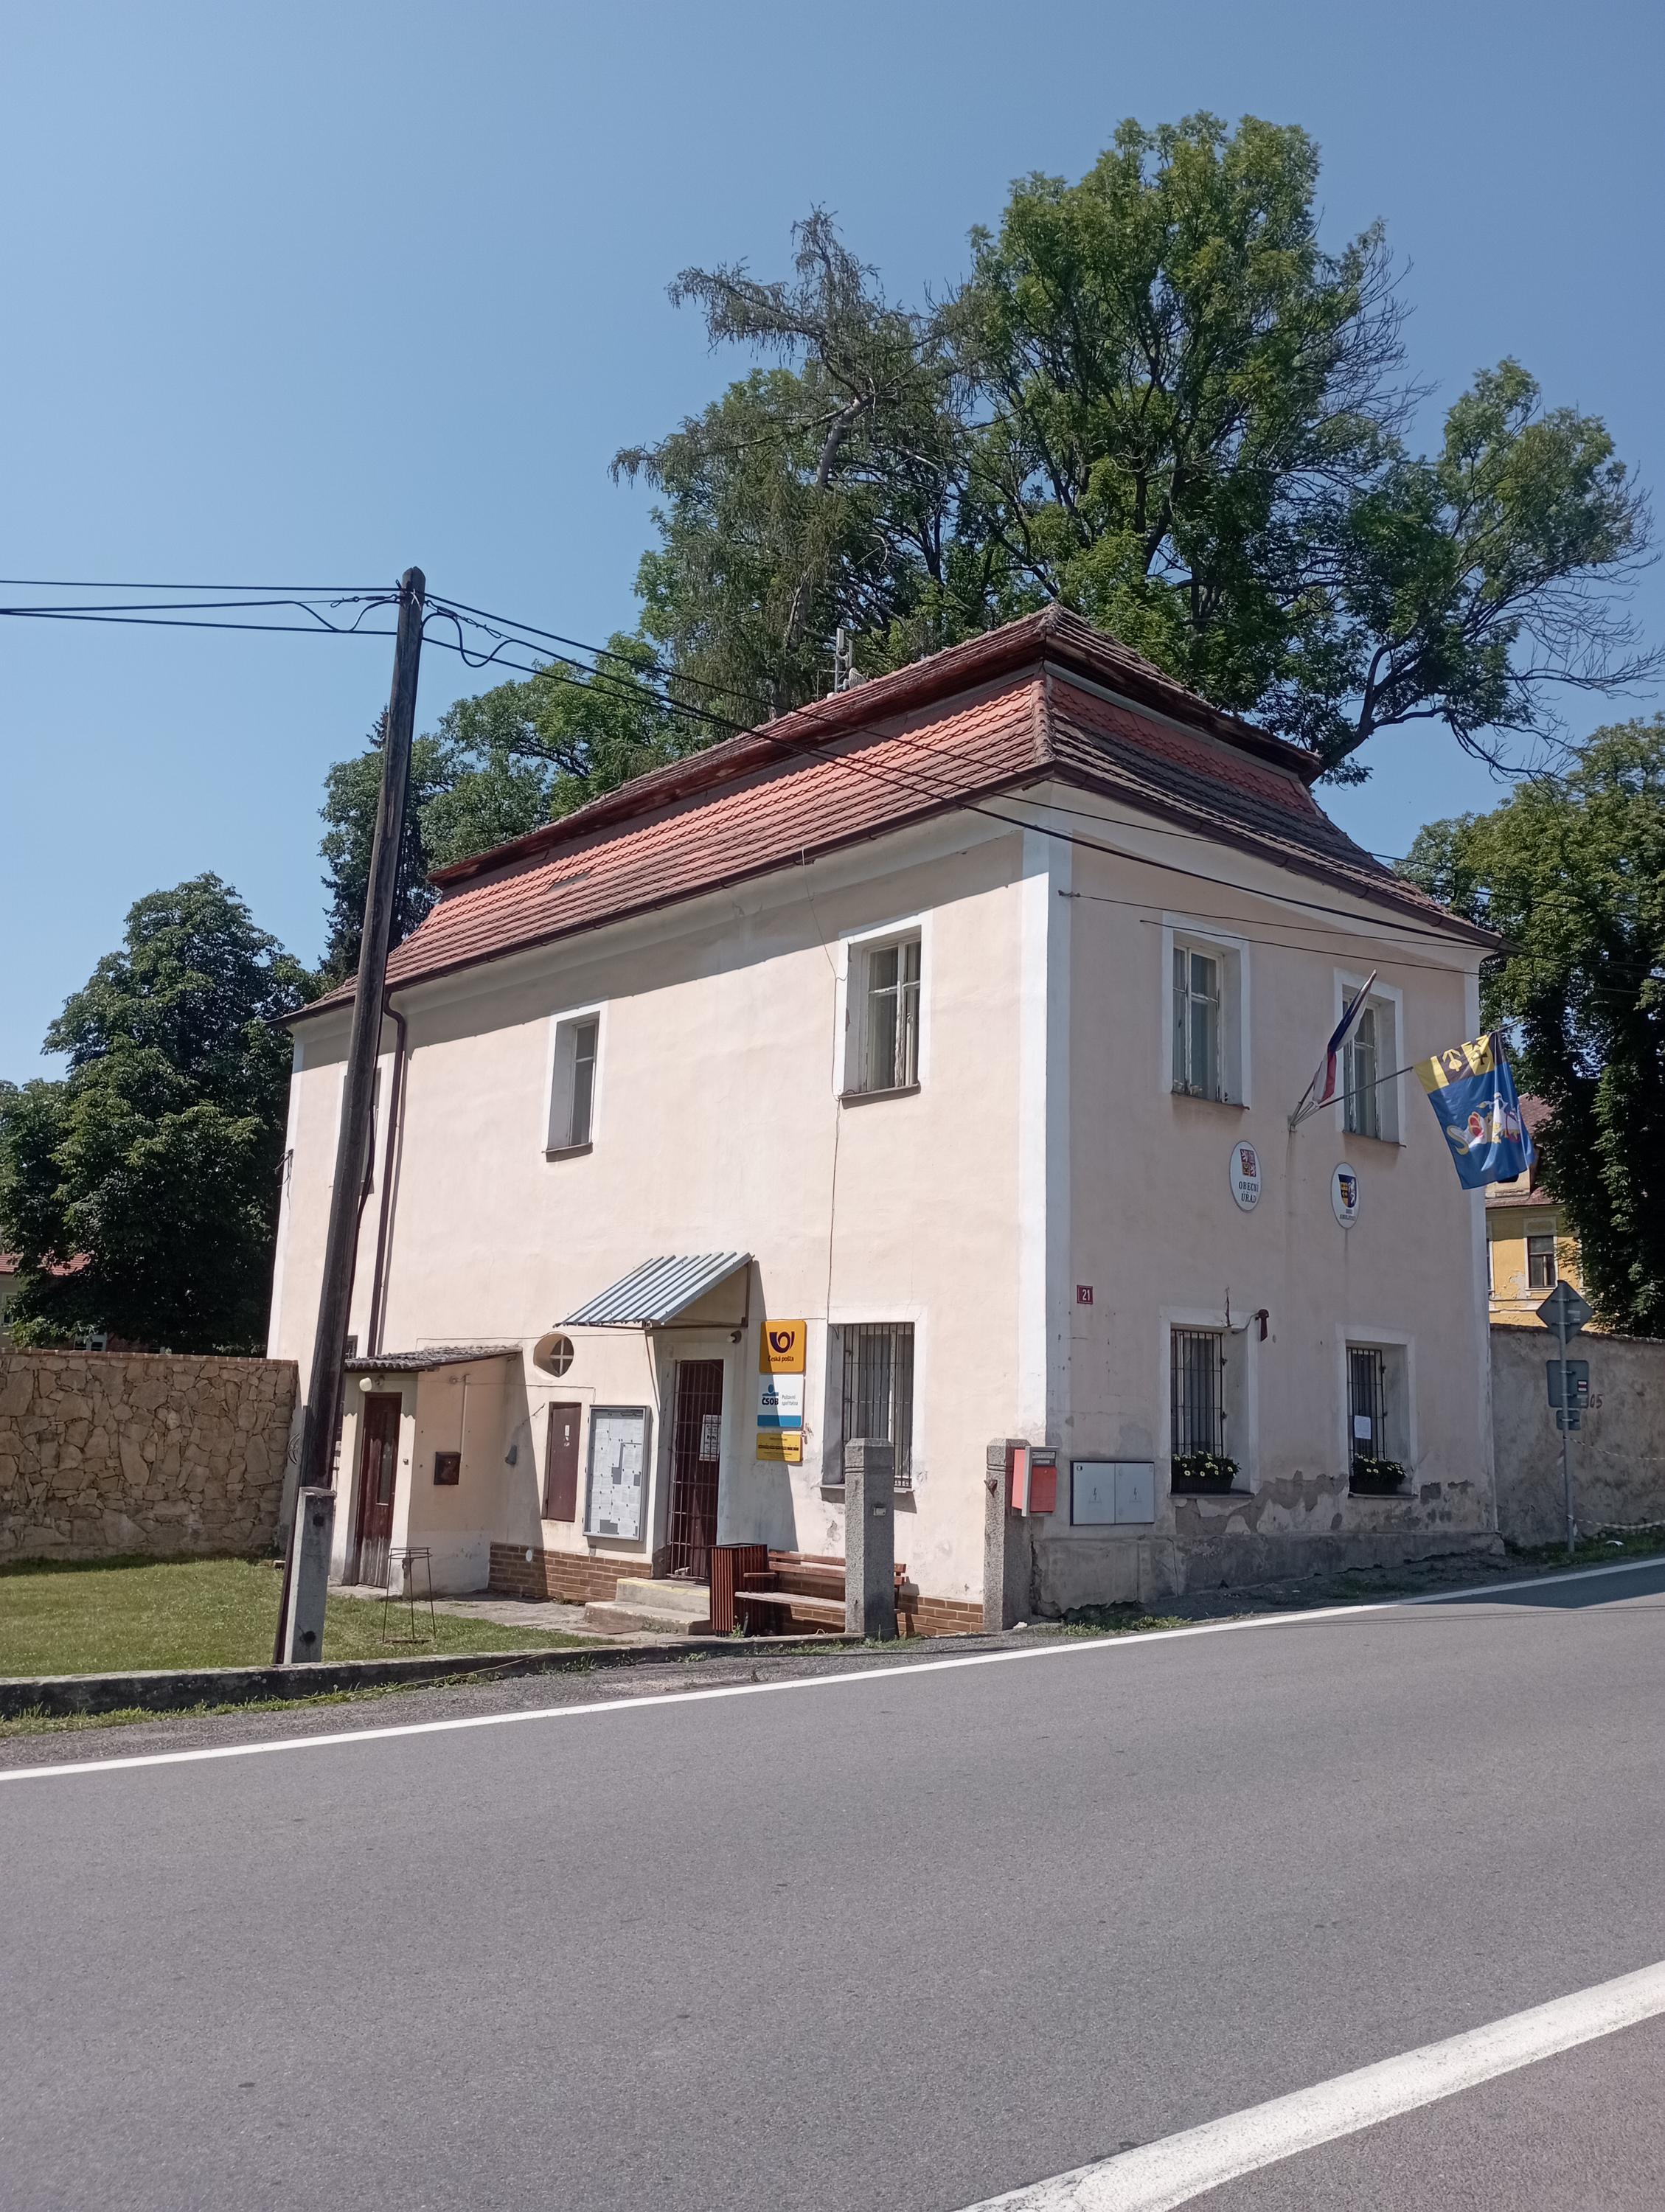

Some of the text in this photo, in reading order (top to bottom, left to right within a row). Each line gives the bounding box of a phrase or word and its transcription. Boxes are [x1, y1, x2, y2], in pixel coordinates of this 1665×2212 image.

[1239, 1181, 1259, 1192] OBECNÍ
[1241, 1191, 1256, 1203] ÚŘAD
[1082, 1289, 1090, 1301] 21
[762, 1397, 779, 1405] ČSOB
